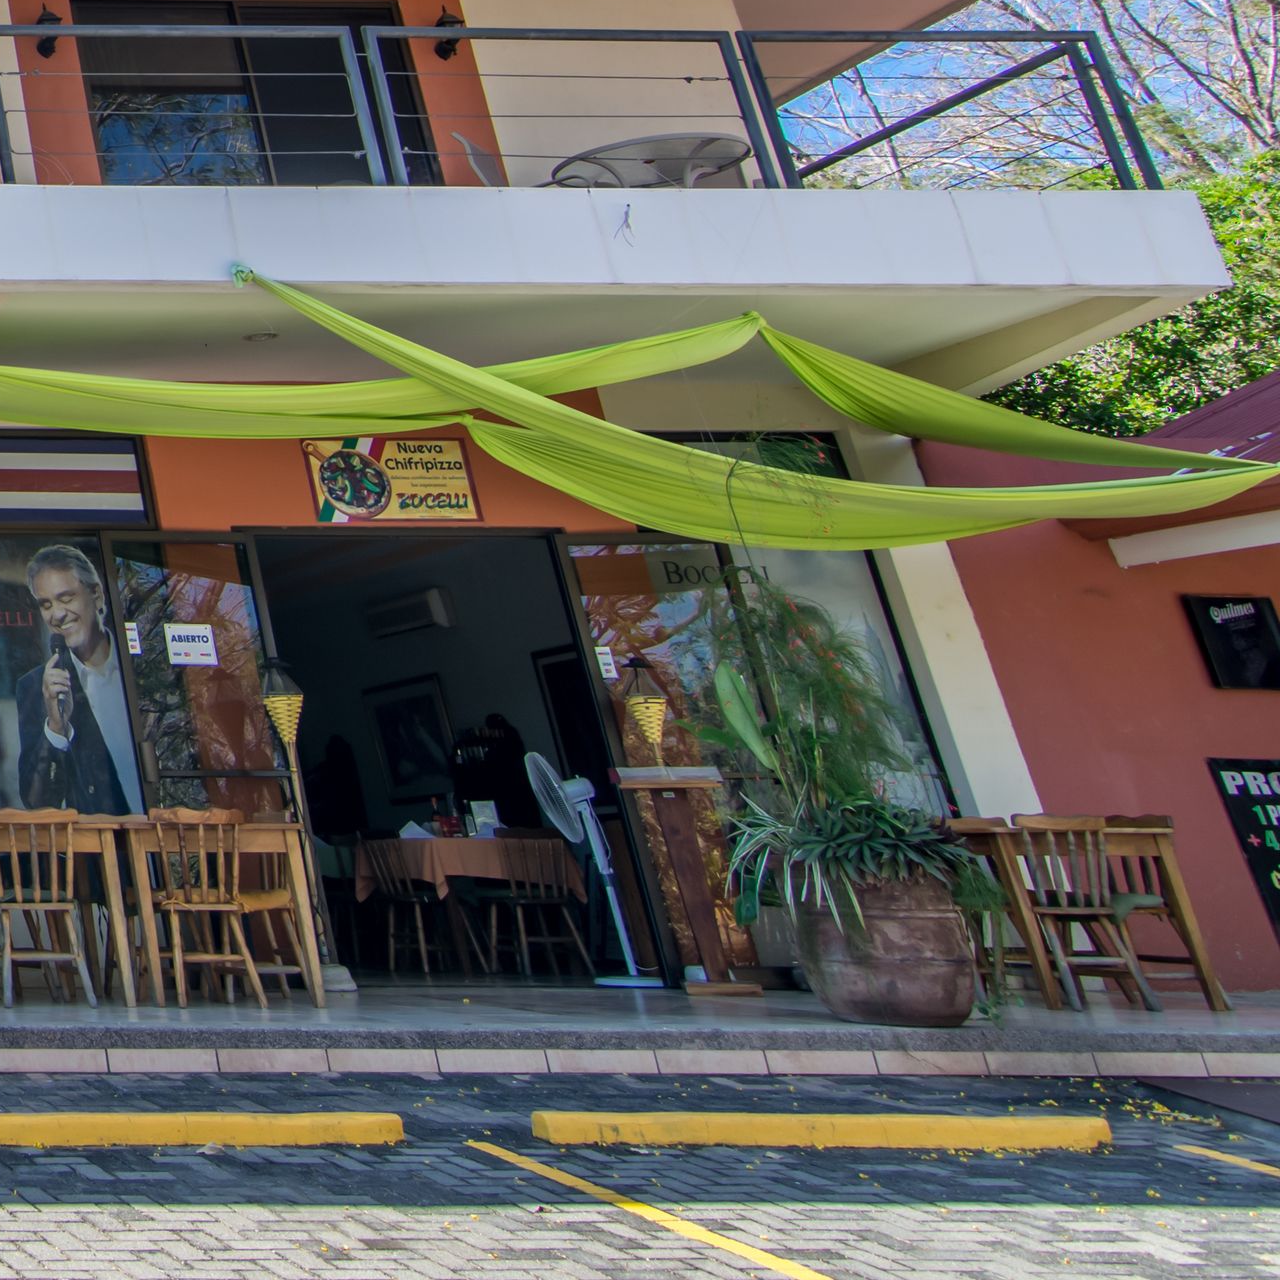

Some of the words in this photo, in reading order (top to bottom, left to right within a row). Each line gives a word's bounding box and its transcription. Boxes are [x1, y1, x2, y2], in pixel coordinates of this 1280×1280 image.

[397, 442, 443, 454] Nueva
[384, 458, 463, 473] Chifripizza
[396, 493, 469, 509] BOCELLI
[1209, 602, 1255, 624] Quilmes
[171, 634, 209, 643] ABIERTO
